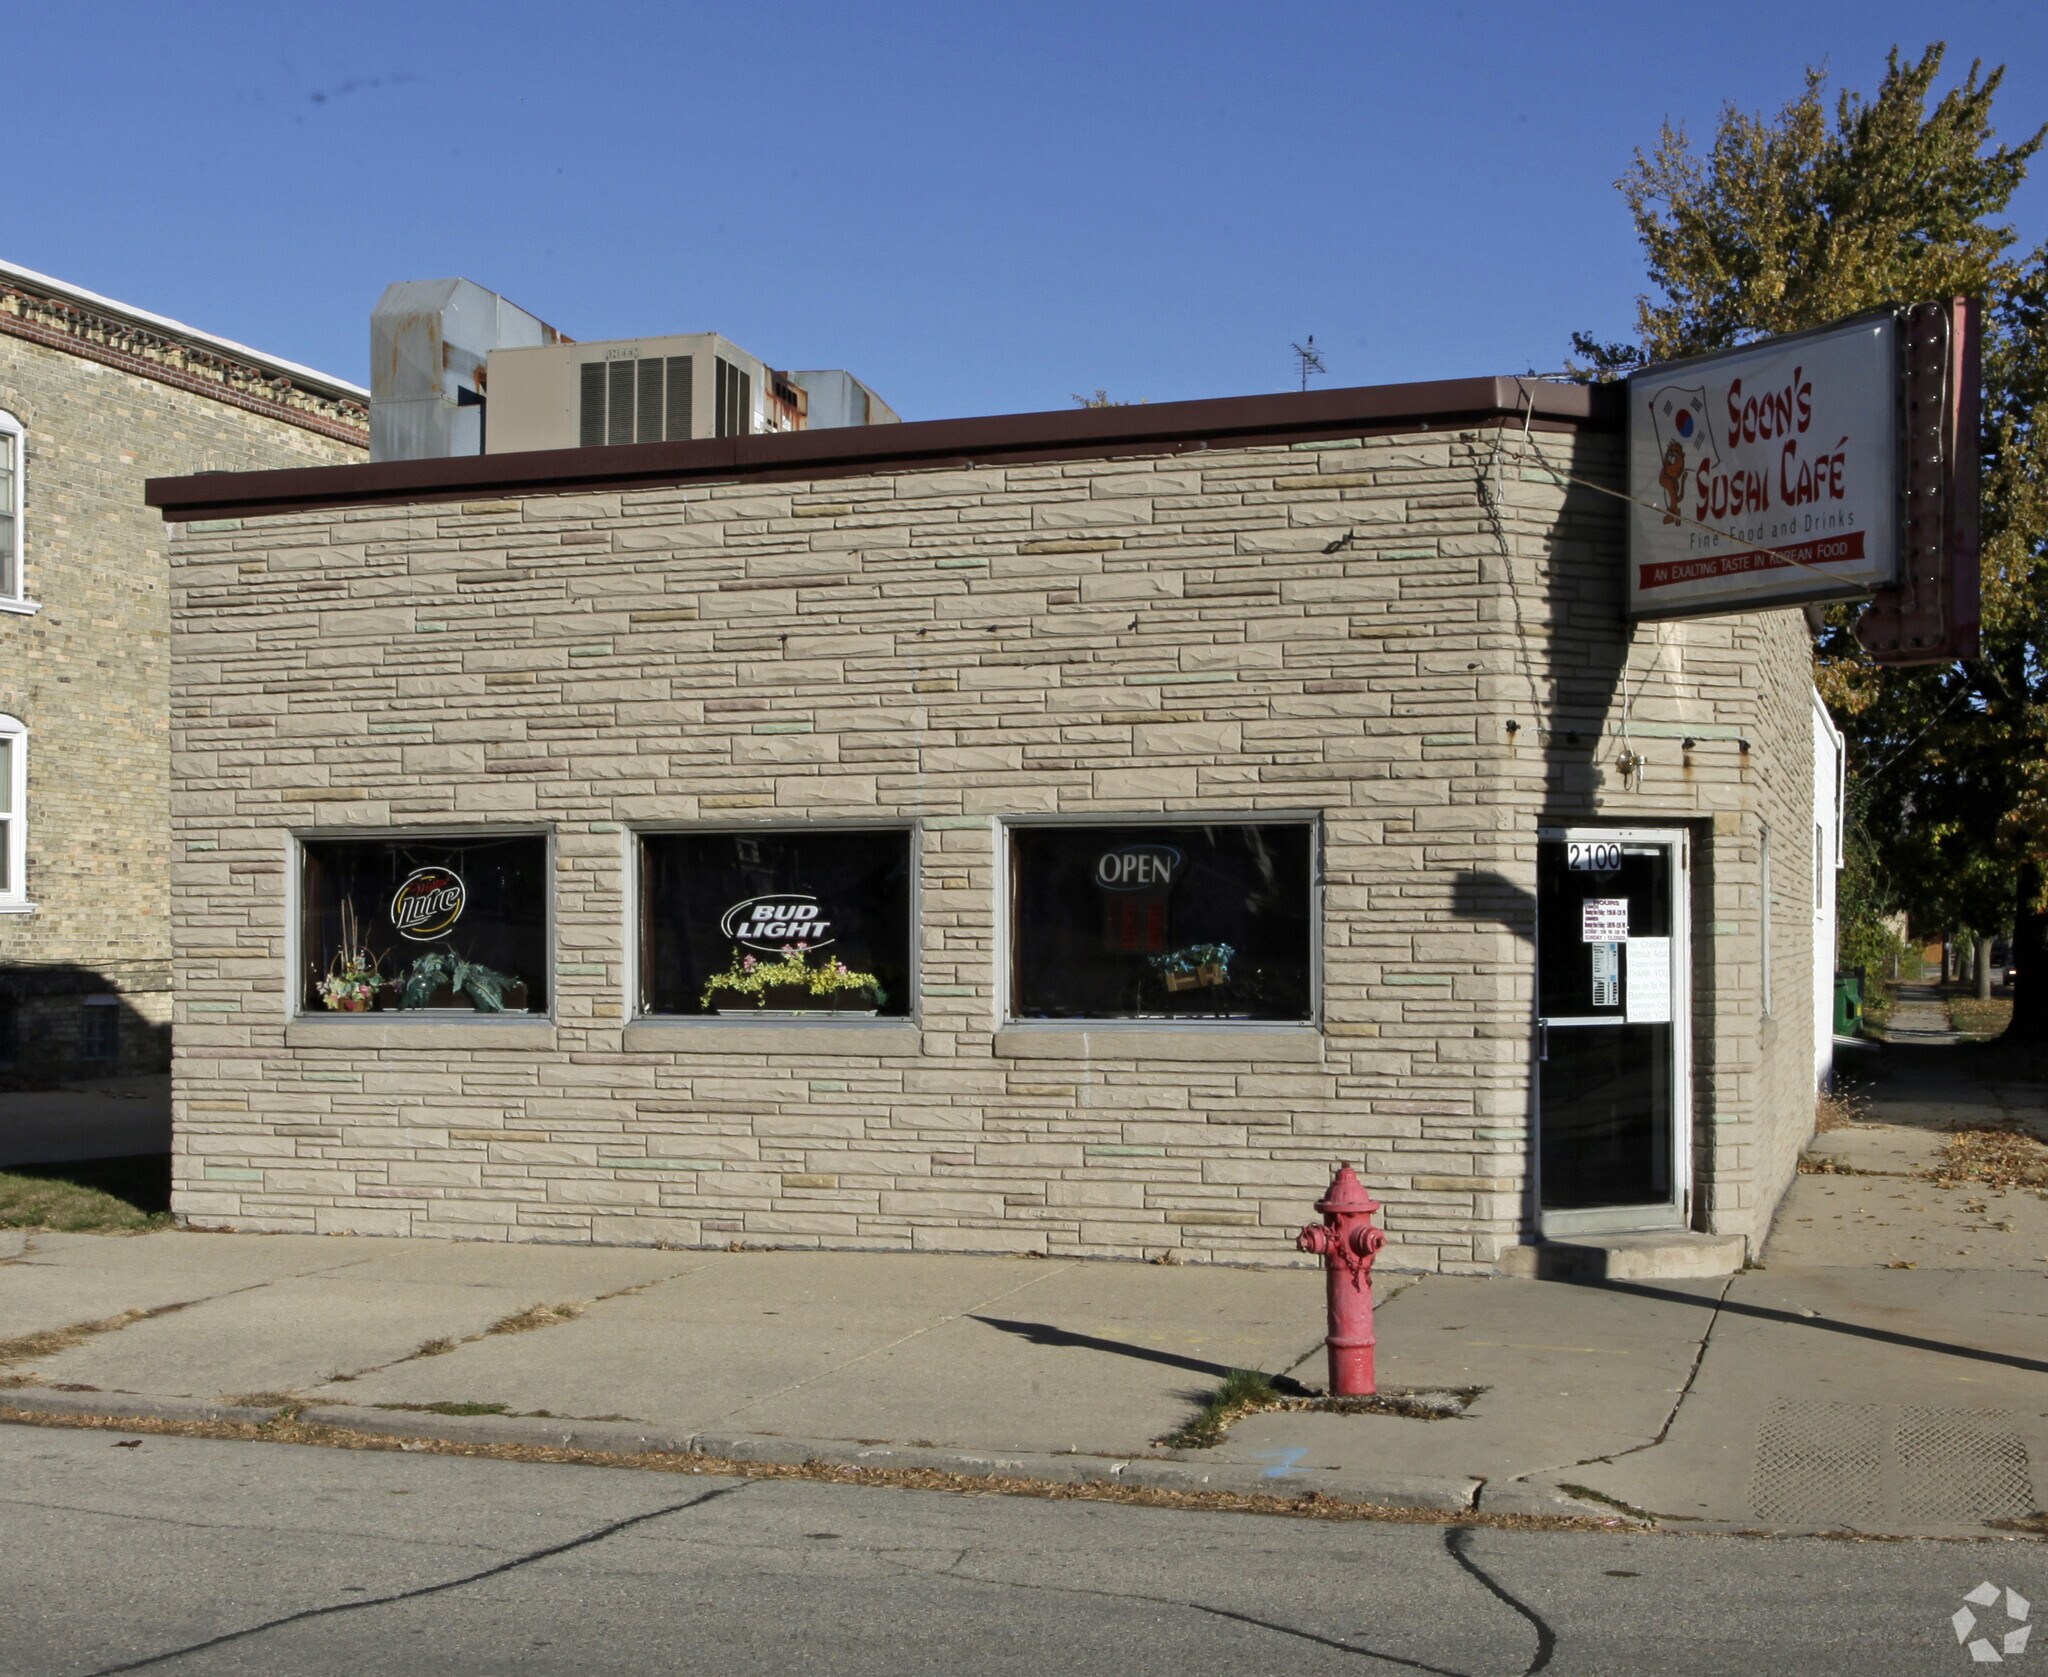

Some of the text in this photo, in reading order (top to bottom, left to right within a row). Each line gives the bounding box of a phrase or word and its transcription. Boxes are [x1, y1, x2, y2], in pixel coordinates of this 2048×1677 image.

[1690, 511, 1854, 549] Fine Food and Drinks
[1654, 541, 1848, 581] AN EXALTING TASTE IN KOREAN FOOD
[1569, 844, 1620, 870] 2100
[1098, 853, 1171, 883] OPEN
[397, 887, 461, 929] Lite
[751, 905, 819, 920] BUD
[736, 922, 830, 938] LIGHT
[1628, 941, 1638, 949] No
[1629, 970, 1651, 978] THANK
[1629, 1011, 1651, 1020] THANK
